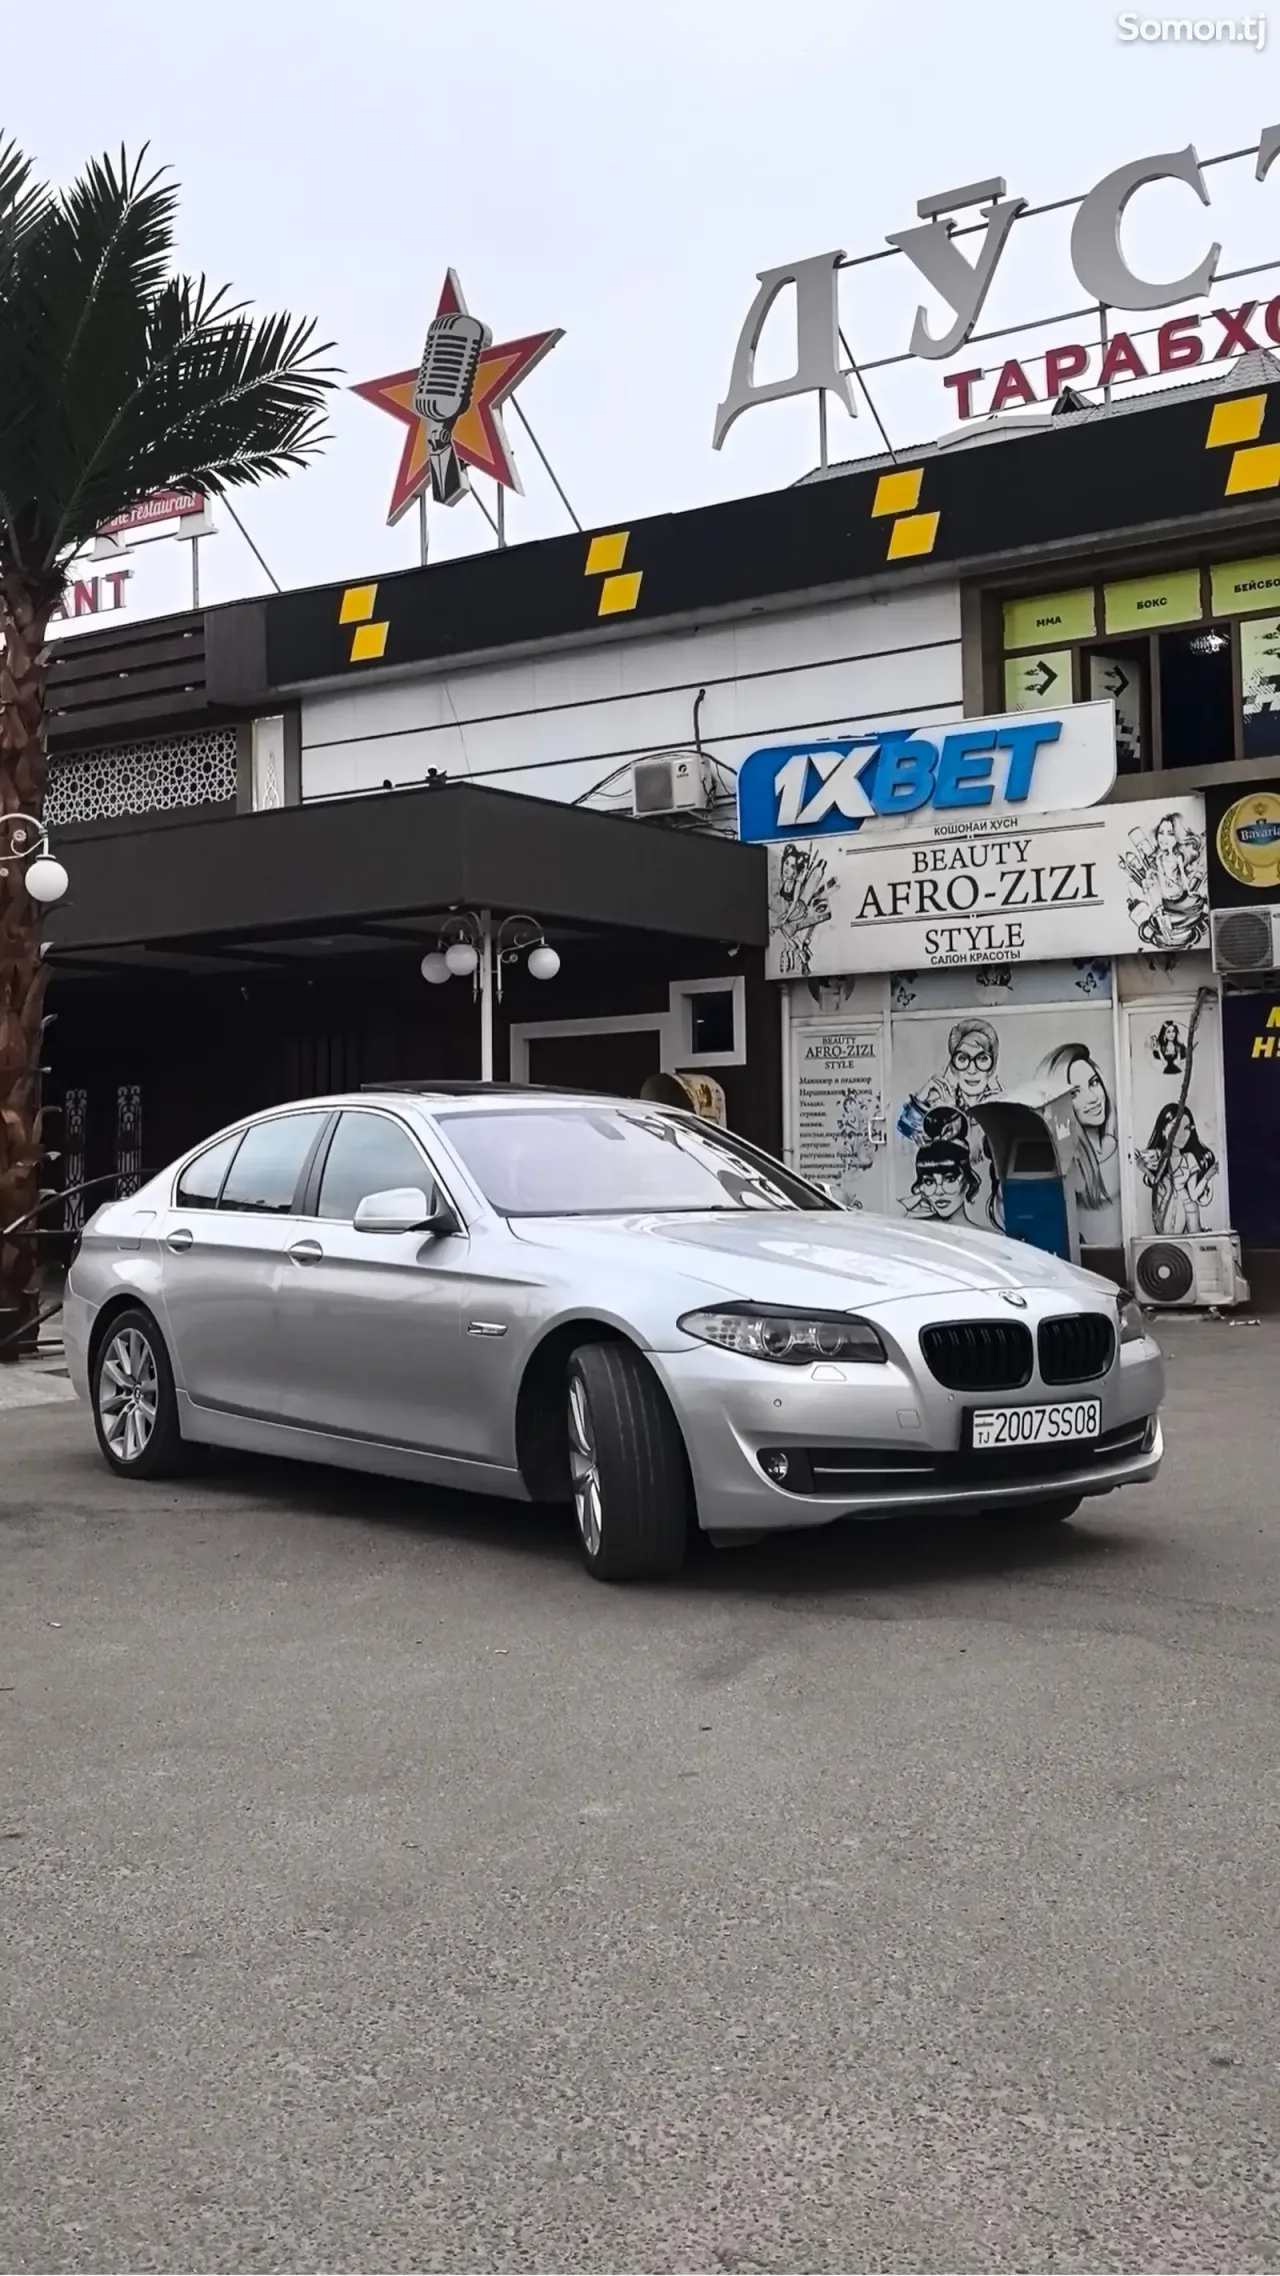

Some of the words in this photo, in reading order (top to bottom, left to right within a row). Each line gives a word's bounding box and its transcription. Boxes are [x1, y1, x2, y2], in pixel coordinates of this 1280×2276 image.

[1136, 597, 1168, 611] БОКС
[775, 721, 1063, 828] 1XBET
[911, 839, 1033, 874] BEAUTY
[855, 863, 1100, 920] AFRO-ZIZI
[925, 923, 1025, 955] STYLE
[930, 954, 967, 966] САЛОН
[969, 949, 1021, 962] КРАСОТЫ
[822, 1036, 857, 1045] BEAUTY
[805, 1044, 874, 1058] AFRO-ZIZI
[824, 1060, 855, 1070] STYLE
[978, 1431, 990, 1444] TJ
